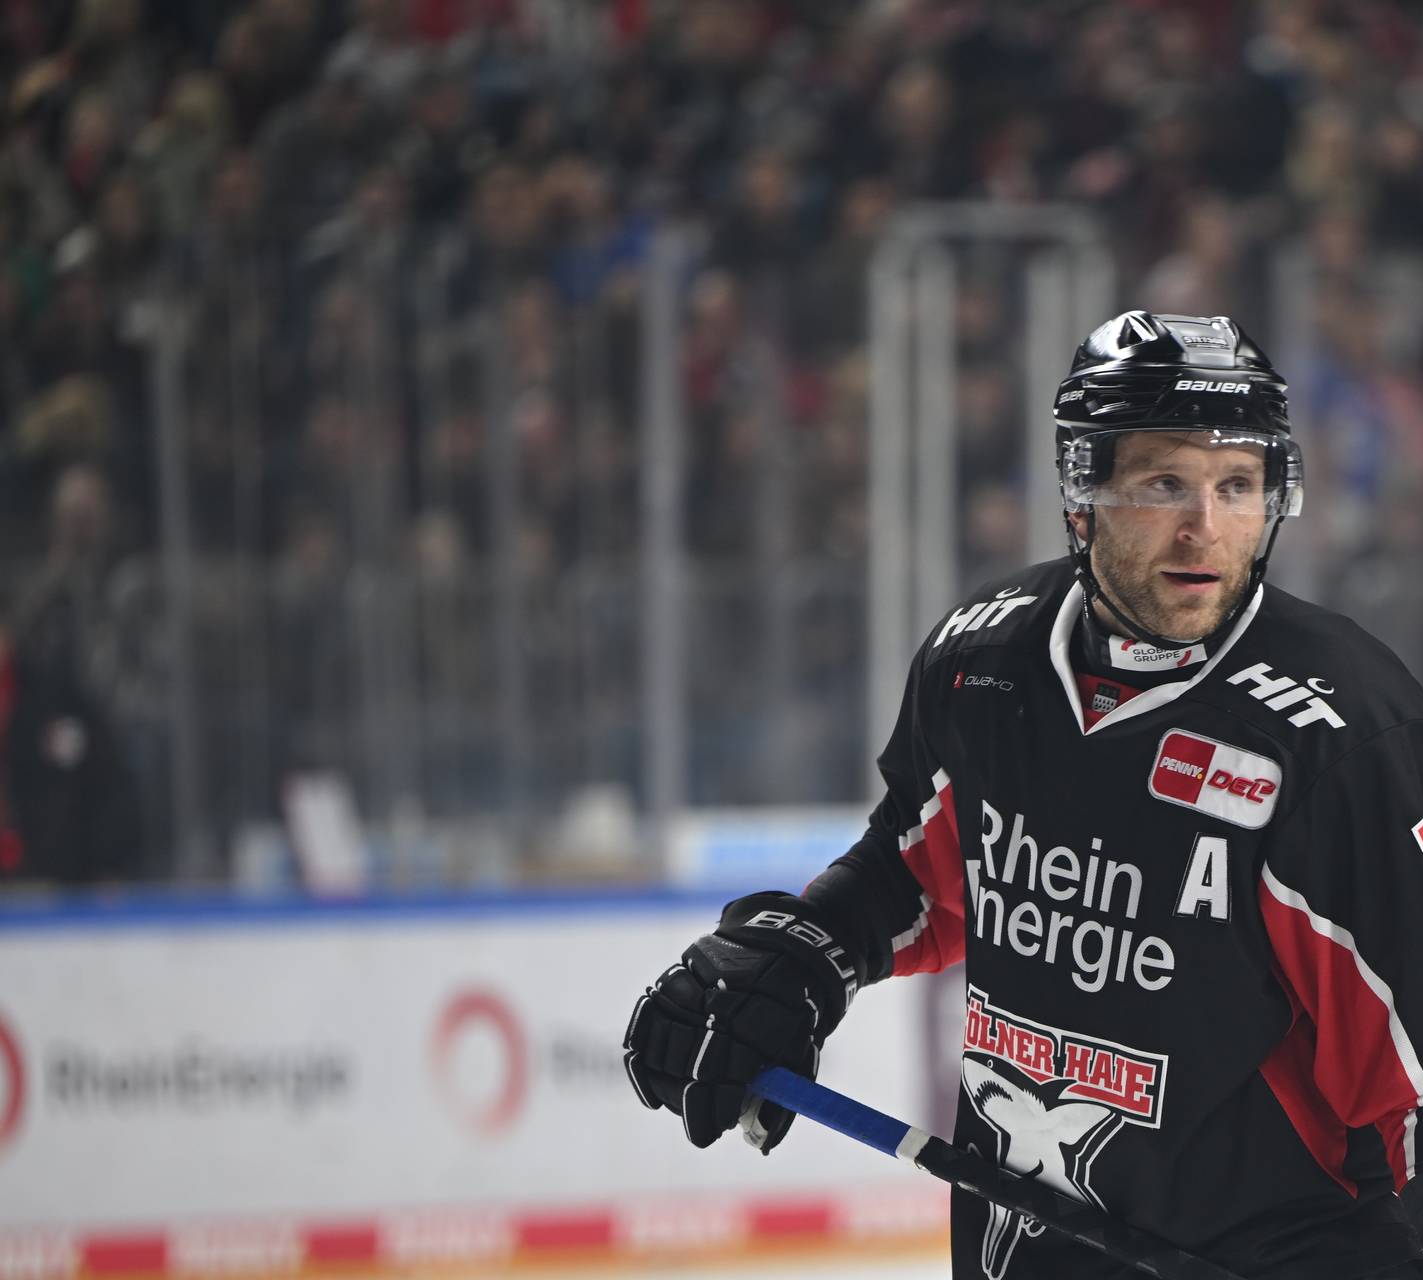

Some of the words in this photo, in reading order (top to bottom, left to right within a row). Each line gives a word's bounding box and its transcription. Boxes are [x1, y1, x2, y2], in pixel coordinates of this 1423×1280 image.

[932, 593, 1039, 648] HIT
[1133, 650, 1181, 663] GRUPPE
[1225, 661, 1347, 729] HIT
[1176, 835, 1230, 922] A
[964, 996, 1055, 1077] ÖLNER
[1063, 1042, 1157, 1118] HAIE
